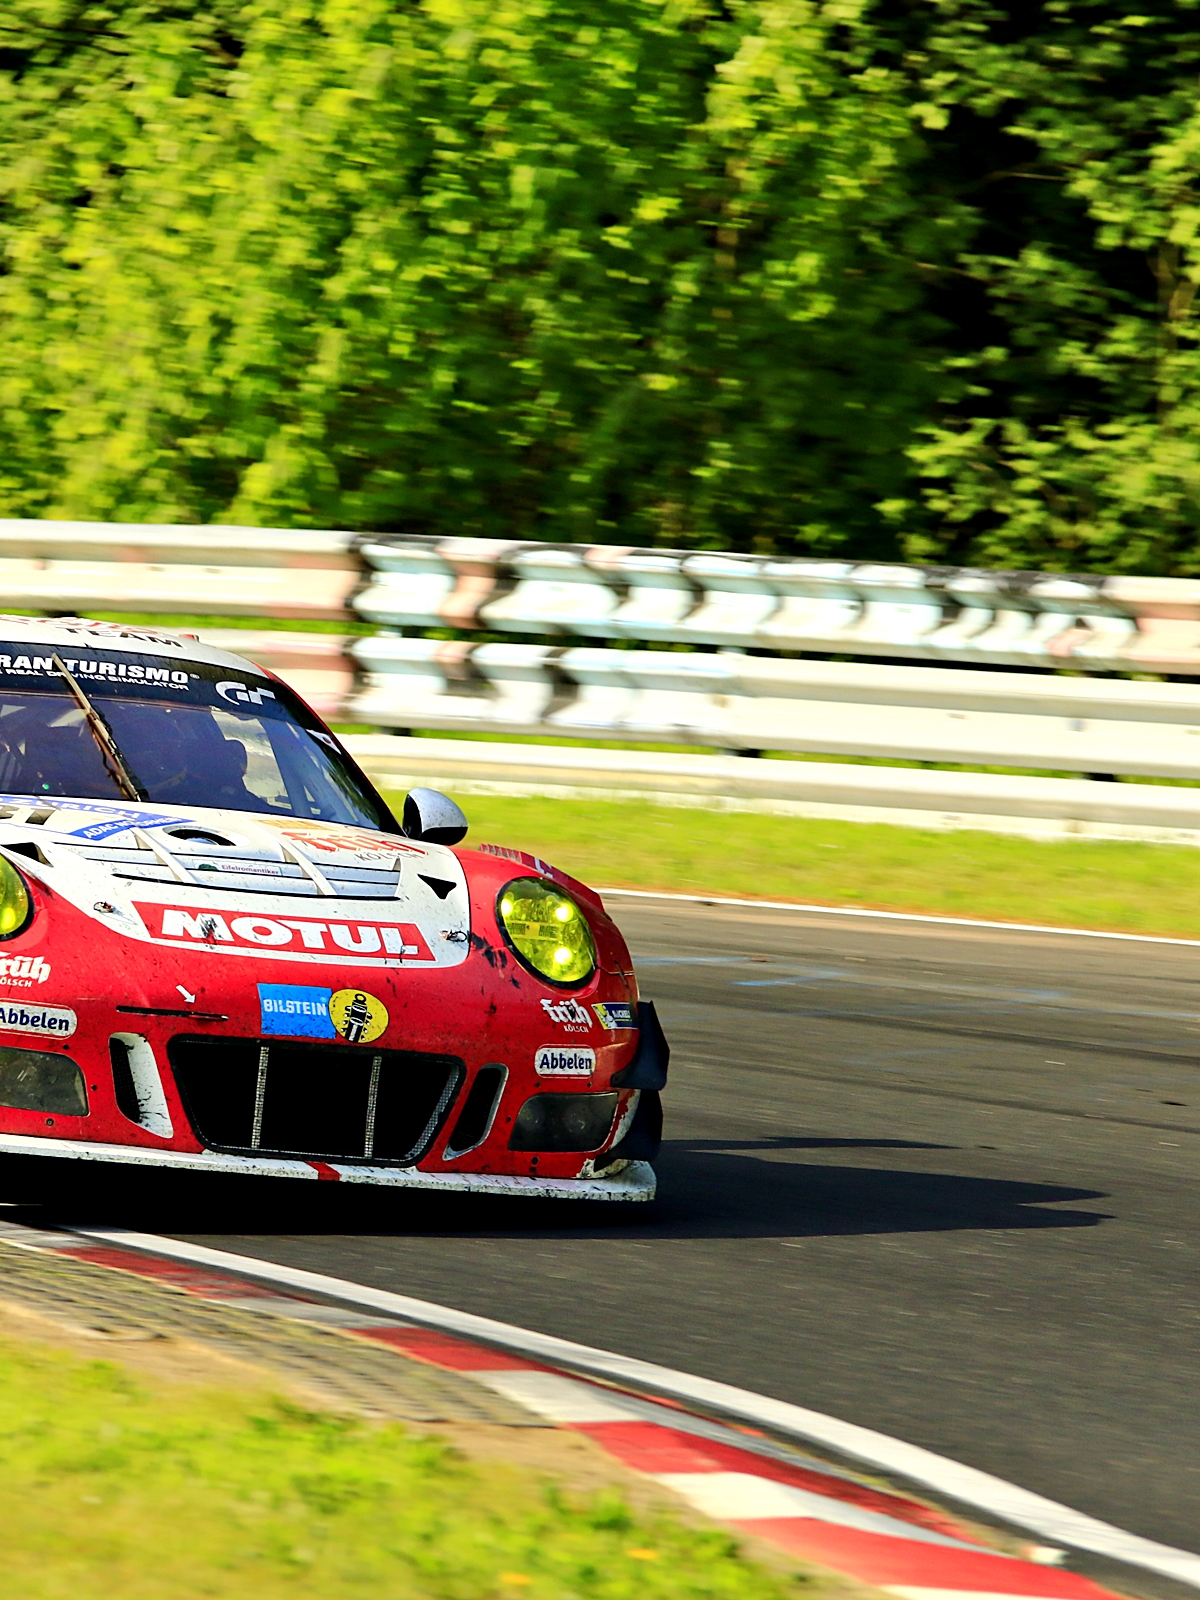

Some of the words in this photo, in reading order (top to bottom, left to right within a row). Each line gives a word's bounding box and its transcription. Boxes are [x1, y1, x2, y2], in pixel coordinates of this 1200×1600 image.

[7, 668, 44, 678] REAL
[46, 670, 107, 682] DRVING
[108, 675, 190, 691] SIMULATOR
[63, 658, 189, 685] TURISMO
[83, 822, 119, 838] ADAC
[161, 909, 419, 955] MOTUL
[263, 998, 328, 1017] BILSTEIN
[539, 1053, 592, 1070] Abbelen
